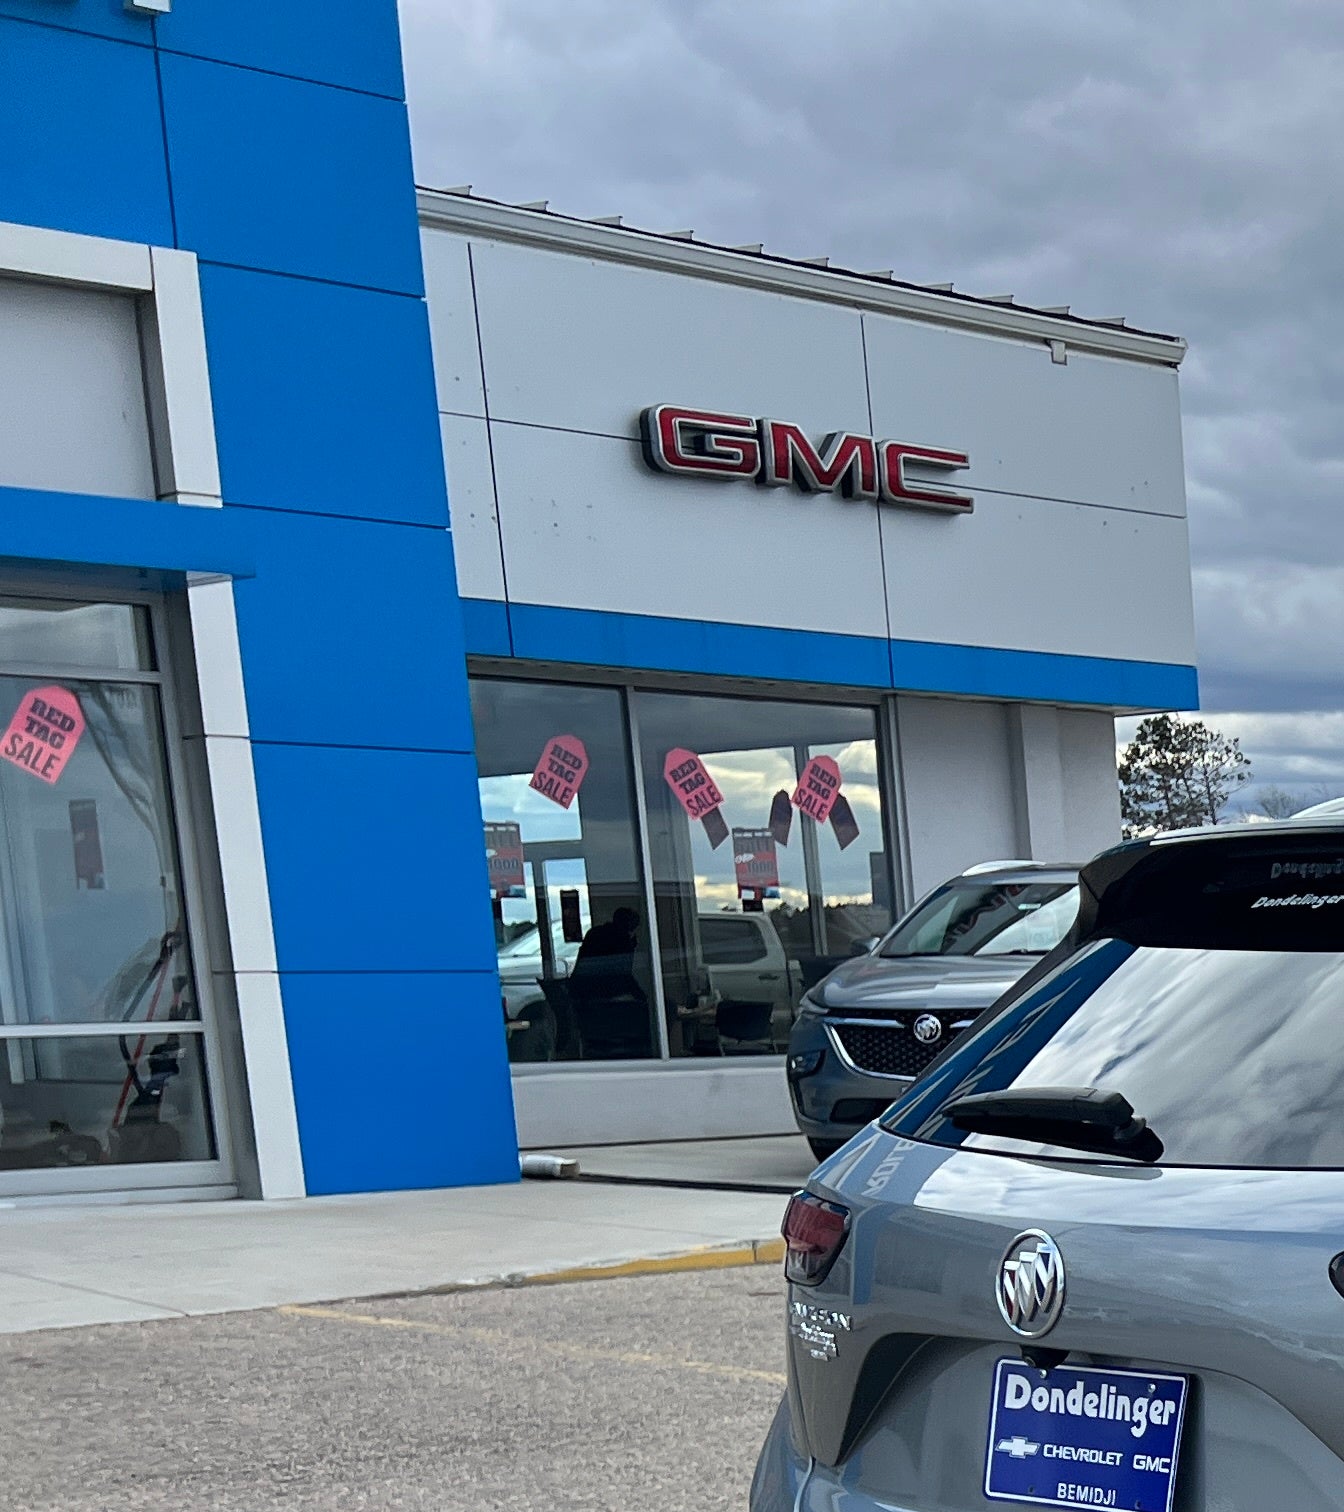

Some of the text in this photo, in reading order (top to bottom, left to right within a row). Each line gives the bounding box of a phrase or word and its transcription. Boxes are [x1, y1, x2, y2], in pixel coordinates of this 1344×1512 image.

[642, 403, 974, 514] GMC
[30, 697, 76, 732] RED
[25, 715, 66, 749] TAG
[4, 732, 61, 779] SALE
[548, 757, 576, 784] TAG
[550, 744, 583, 770] RED
[669, 759, 698, 783] RED
[534, 771, 574, 805] SALE
[679, 772, 706, 795] TAG
[807, 775, 831, 800] TAG
[810, 763, 837, 789] RED
[686, 785, 722, 817] SALE
[795, 787, 828, 820] SALE
[1004, 1373, 1176, 1438] Dondelinger
[1042, 1443, 1171, 1474] CHEVROLET GMC
[1057, 1482, 1116, 1506] BEMIDJI
